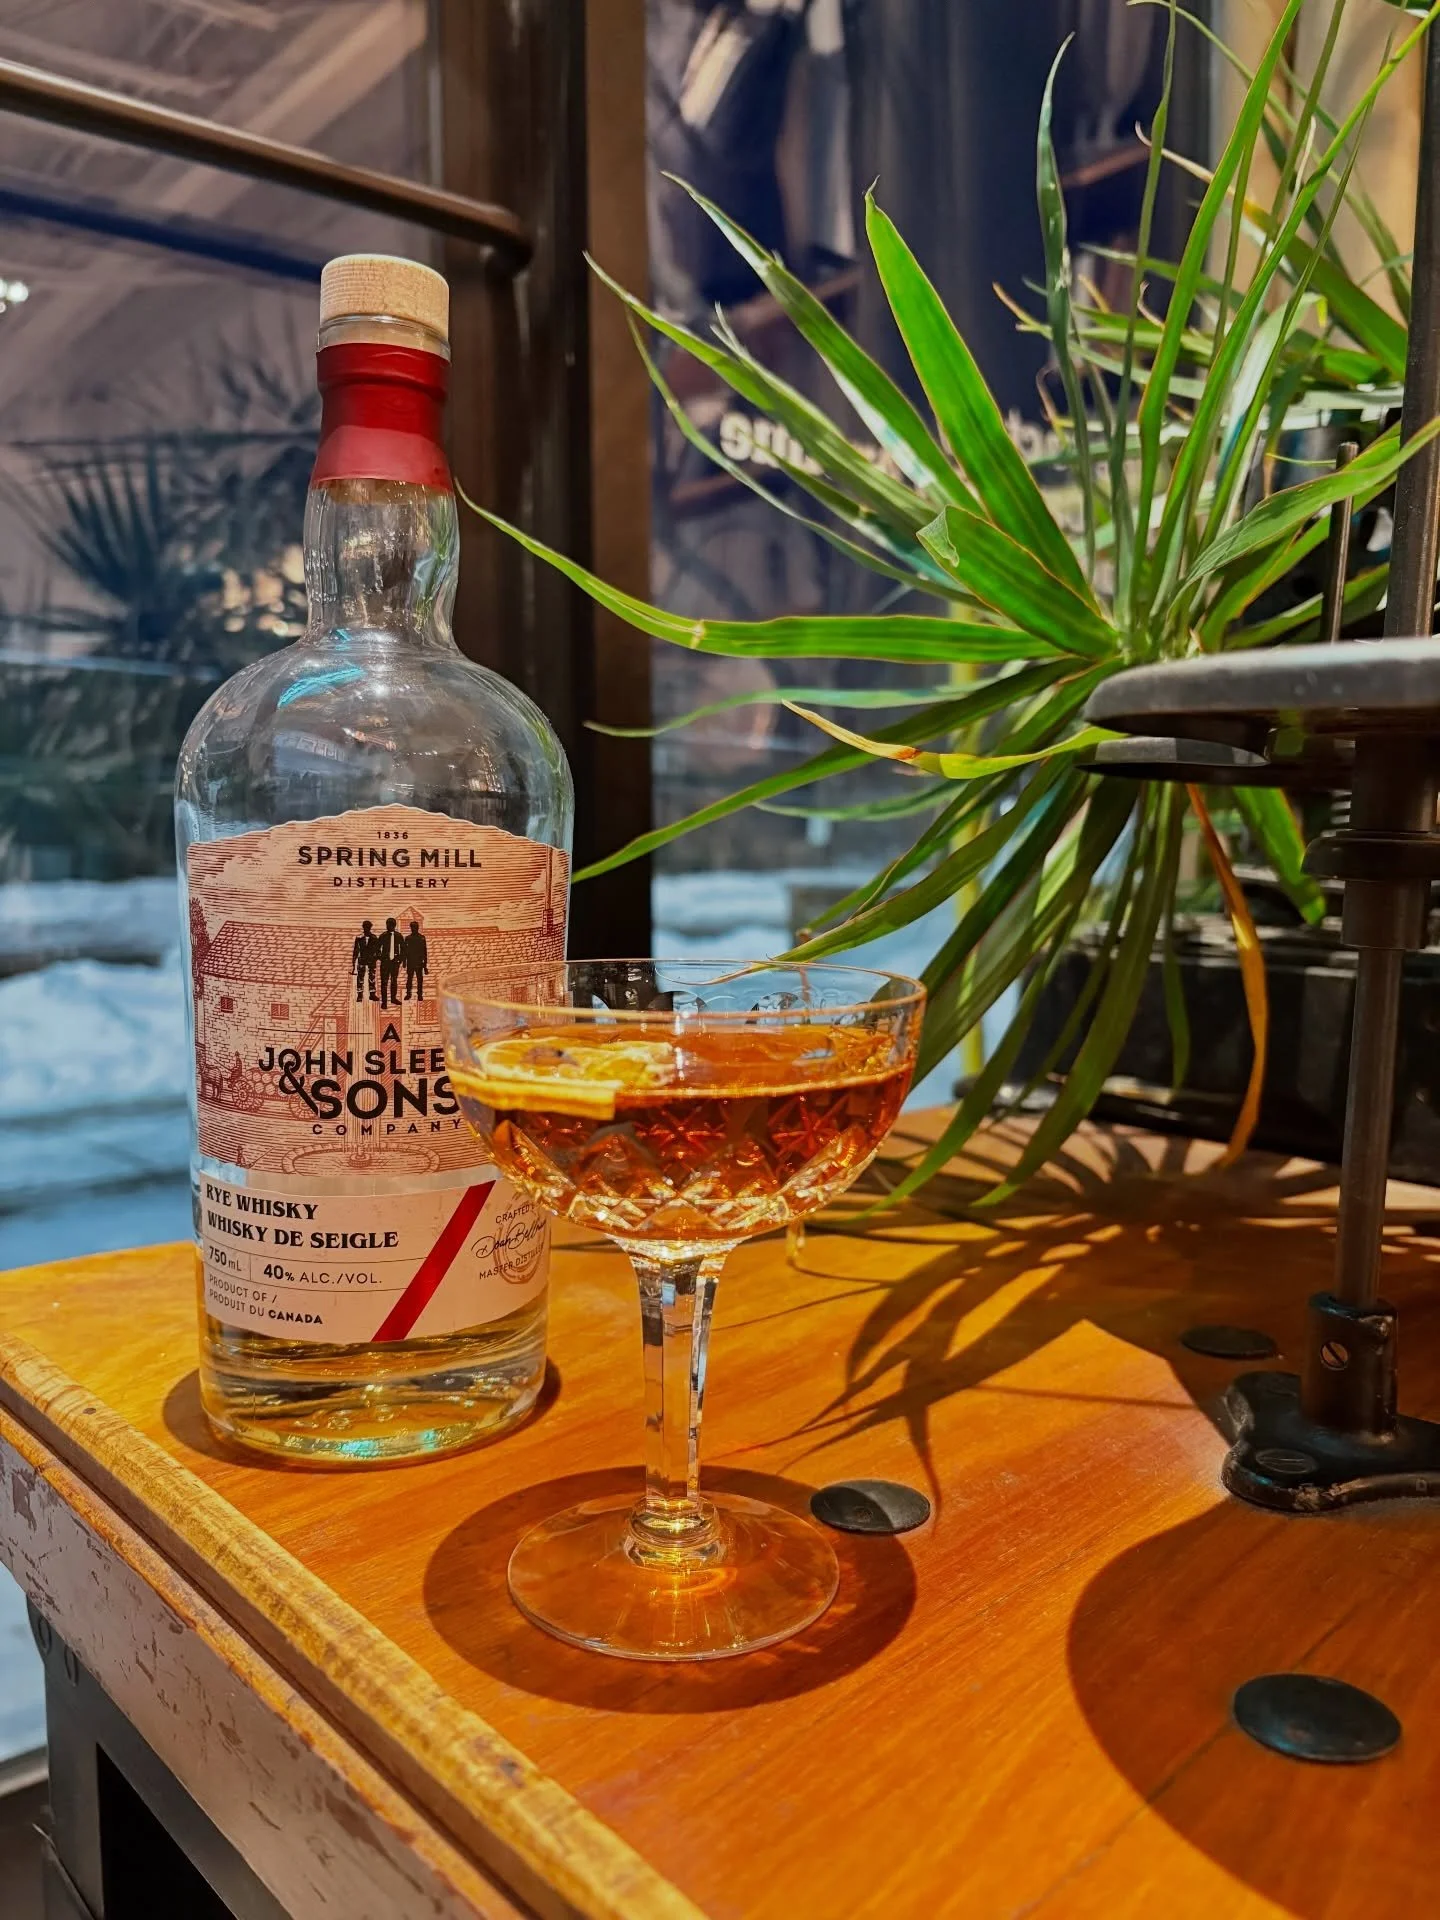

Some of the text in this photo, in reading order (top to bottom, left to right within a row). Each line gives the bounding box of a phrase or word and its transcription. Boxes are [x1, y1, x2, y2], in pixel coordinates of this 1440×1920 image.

[377, 831, 409, 840] 1836
[298, 846, 410, 868] SPRING
[333, 876, 449, 889] DISTILLERY
[381, 1022, 401, 1043] A
[258, 1046, 446, 1076] JOHN SLEE
[310, 1074, 461, 1120] SONS
[312, 1118, 462, 1136] COMPANY
[206, 1183, 319, 1220] RYE WHISKY
[495, 1203, 530, 1225] CRAFTED
[207, 1210, 399, 1249] WHISKY DE SEIGLE
[263, 1263, 382, 1285] 40% ALC./VOL.
[479, 1261, 513, 1280] MASTER
[209, 1274, 248, 1298] PRODUCT
[252, 1290, 267, 1302] OF
[209, 1288, 323, 1325] PRODUIT DU CANADA
